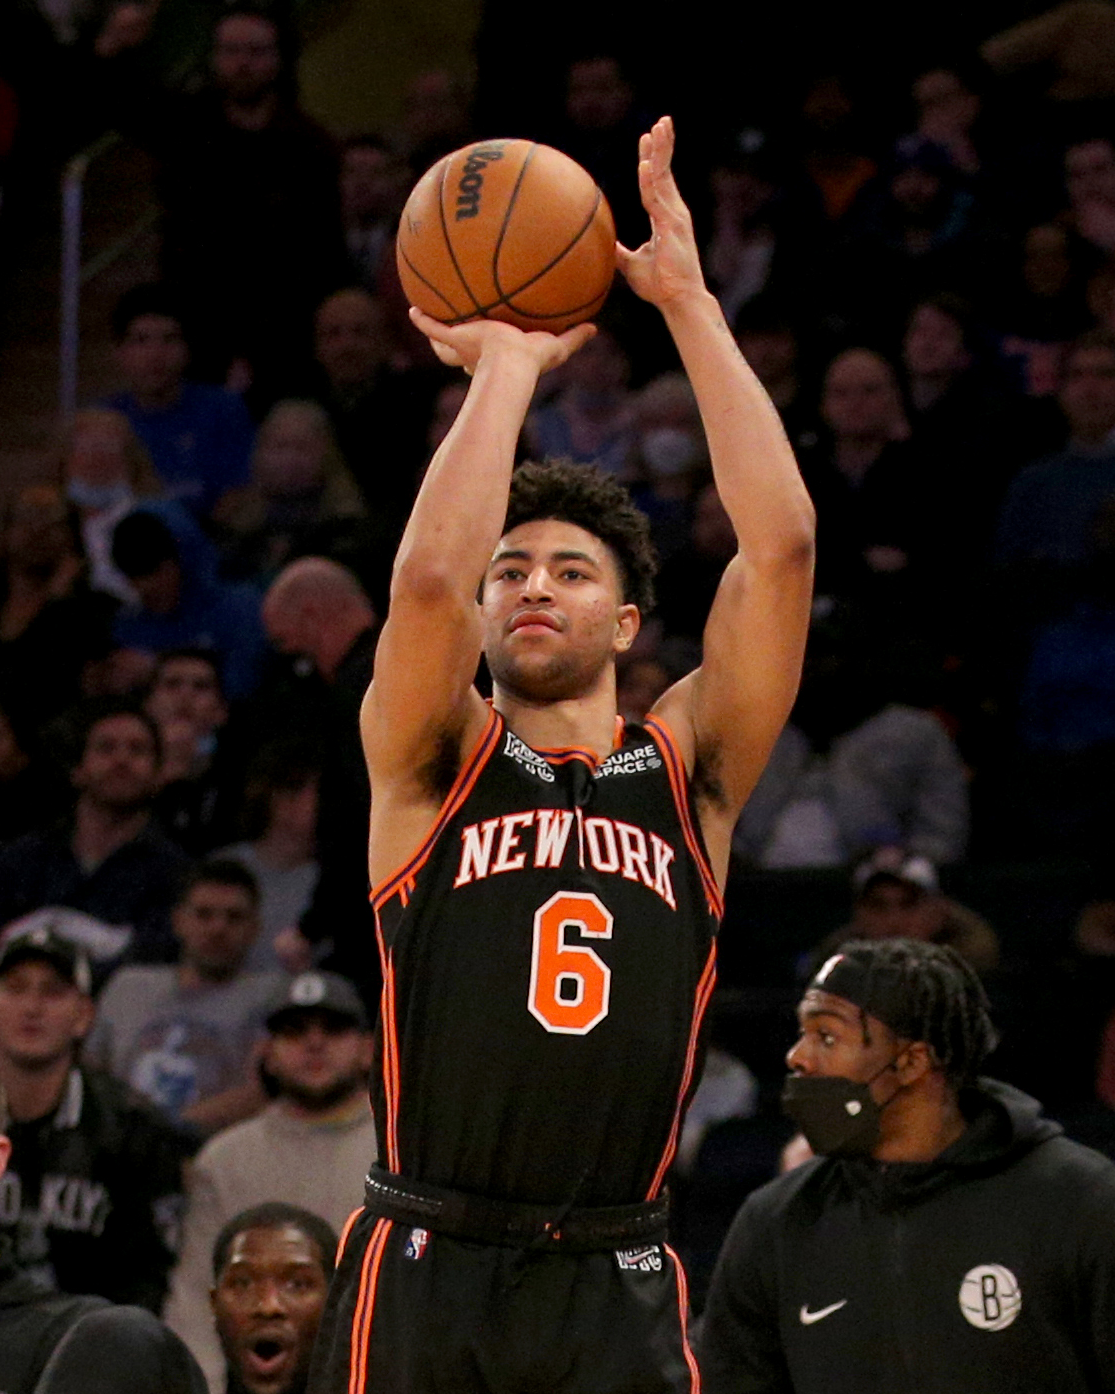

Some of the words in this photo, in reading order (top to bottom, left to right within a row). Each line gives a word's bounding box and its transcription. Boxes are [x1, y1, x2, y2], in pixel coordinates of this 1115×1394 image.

[453, 808, 575, 889] NEW
[575, 805, 677, 911] ORK
[527, 890, 614, 1036] 6
